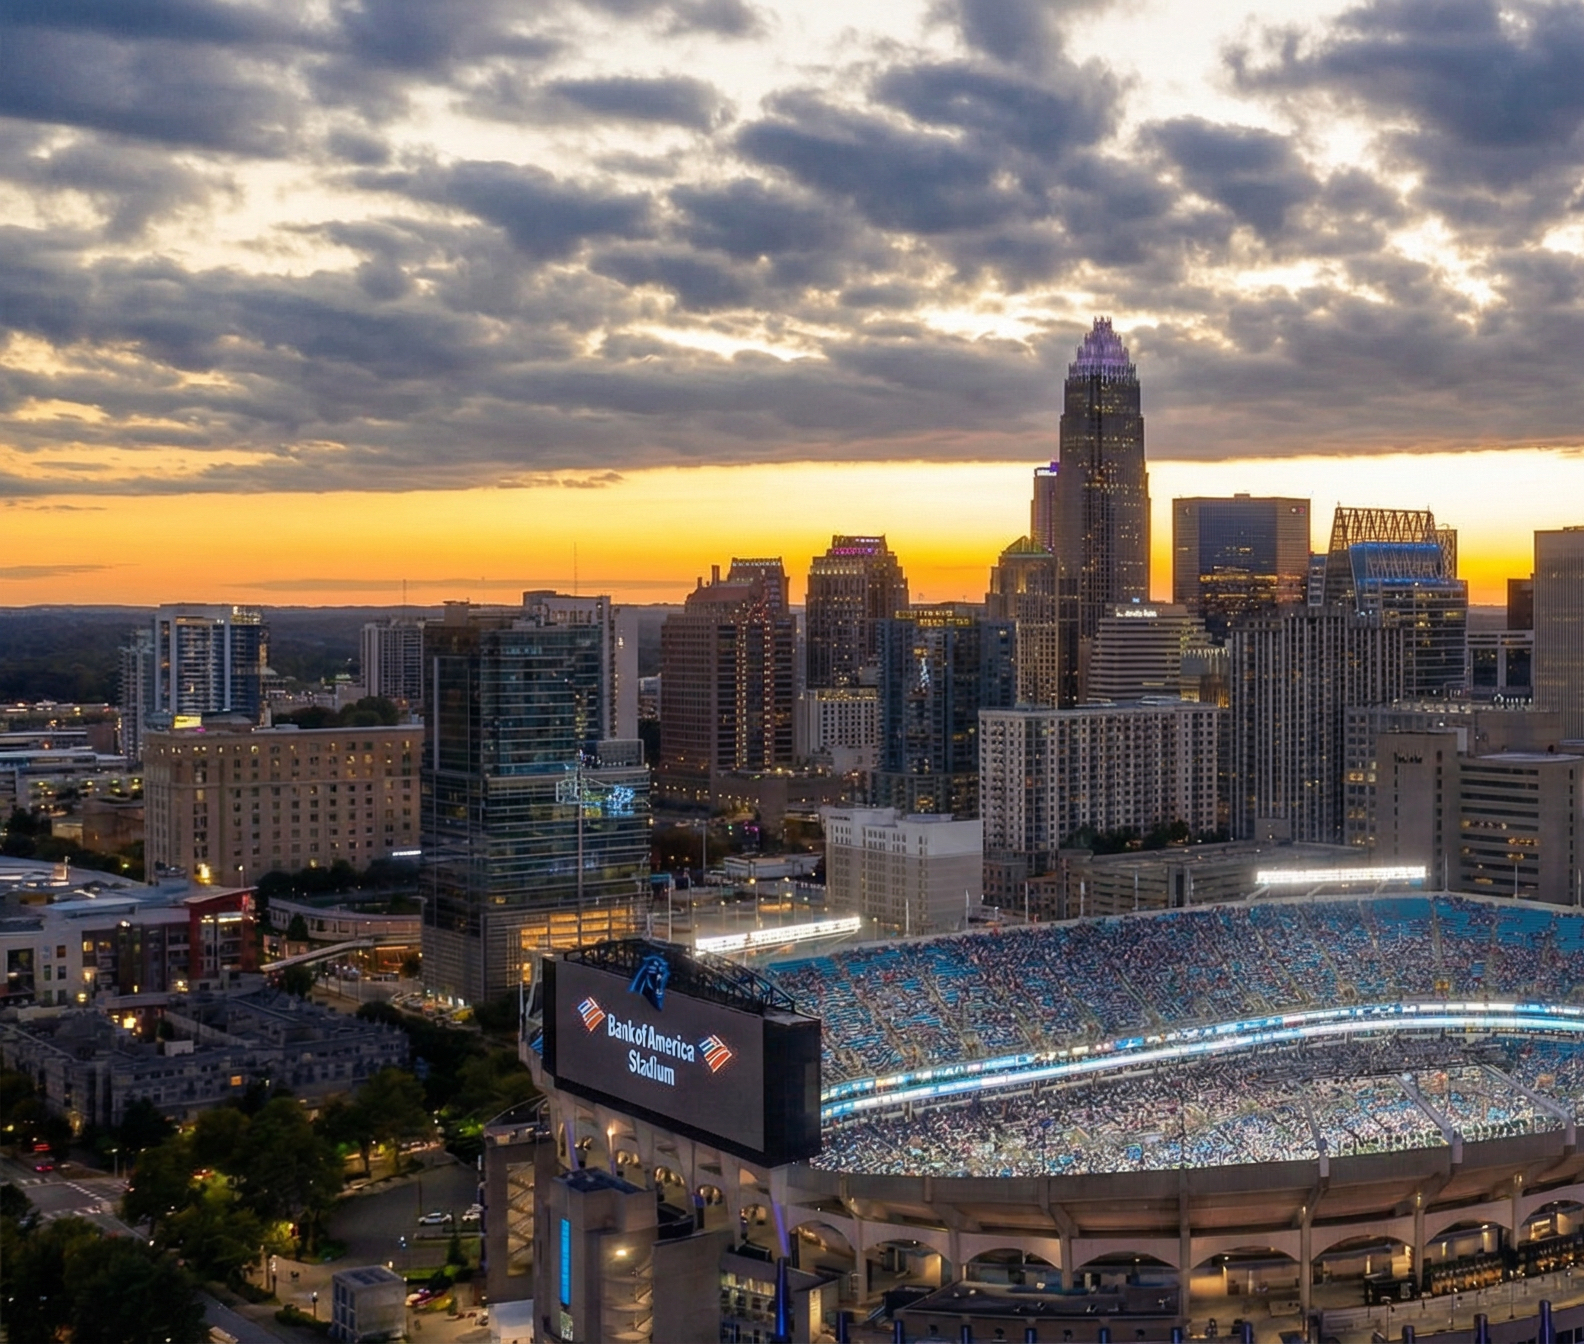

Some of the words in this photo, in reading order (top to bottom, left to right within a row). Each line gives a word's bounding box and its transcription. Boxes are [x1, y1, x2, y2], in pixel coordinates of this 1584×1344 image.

[608, 1013, 634, 1044] Bank
[635, 1023, 648, 1048] of
[648, 1025, 695, 1062] America
[628, 1049, 675, 1086] Stadium
